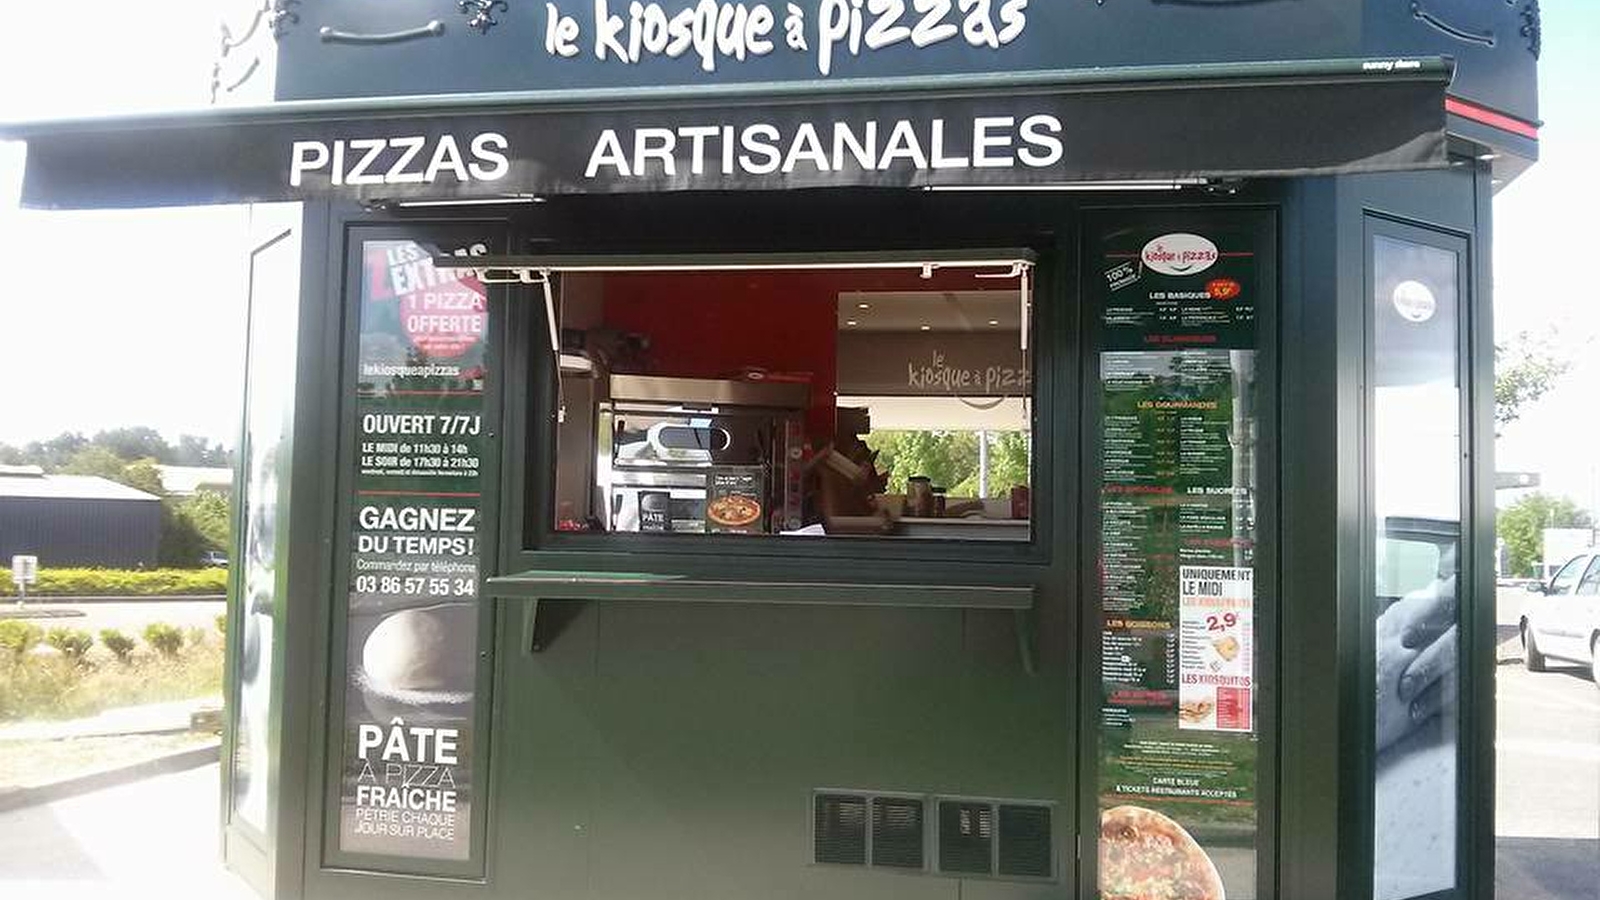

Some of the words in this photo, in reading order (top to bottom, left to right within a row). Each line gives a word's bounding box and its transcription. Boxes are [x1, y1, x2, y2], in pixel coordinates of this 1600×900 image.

[546, 2, 580, 57] le
[595, 0, 775, 72] kiosque
[784, 2, 809, 51] à
[818, 0, 1028, 76] pizzas
[289, 132, 510, 187] PIZZAS
[585, 114, 1065, 179] ARTISANALES
[409, 294, 418, 309] 1
[424, 291, 484, 310] PIZZA
[1149, 291, 1166, 299] LES
[1167, 291, 1212, 300] BASIQUES
[407, 314, 482, 334] OFFERTE
[932, 350, 945, 367] le
[908, 362, 971, 391] kiosque
[1137, 400, 1154, 410] LES
[363, 413, 436, 435] OUVERT
[440, 415, 481, 435] 7/7J
[362, 442, 375, 454] LE
[376, 443, 399, 454] MIDI
[400, 442, 413, 454] de
[413, 443, 442, 455] 11h30
[443, 443, 450, 455] à
[451, 443, 469, 455] 14h
[361, 455, 374, 467] LE
[375, 455, 399, 467] SOIR
[400, 455, 413, 468] de
[413, 456, 442, 468] 17h30
[443, 456, 450, 468] à
[450, 457, 480, 469] 21h30
[1187, 486, 1204, 495] LES
[359, 506, 476, 532] GAGNEZ
[358, 535, 389, 553] DU
[356, 558, 412, 571] Commandez
[413, 562, 430, 573] par
[431, 561, 476, 573] téléphone
[1182, 567, 1252, 582] UNIQUEMENT
[356, 575, 377, 593] 03
[381, 576, 401, 594] 86
[404, 577, 425, 595] 57
[429, 578, 449, 596] 55
[454, 578, 475, 596] 34
[1182, 581, 1197, 596] LE
[1198, 581, 1224, 597] MIDI
[1106, 619, 1124, 629] LES
[1182, 673, 1199, 685] LES
[358, 716, 459, 765] PÂTE
[385, 763, 456, 789] PIZZA
[1152, 776, 1176, 786] CARTE
[1176, 777, 1201, 787] BLEUE
[356, 784, 457, 812] FRAÎCHE
[401, 810, 455, 827] CHAQUE
[354, 821, 387, 836] JOUR
[388, 823, 414, 838] SUR
[416, 826, 455, 841] PLACE
